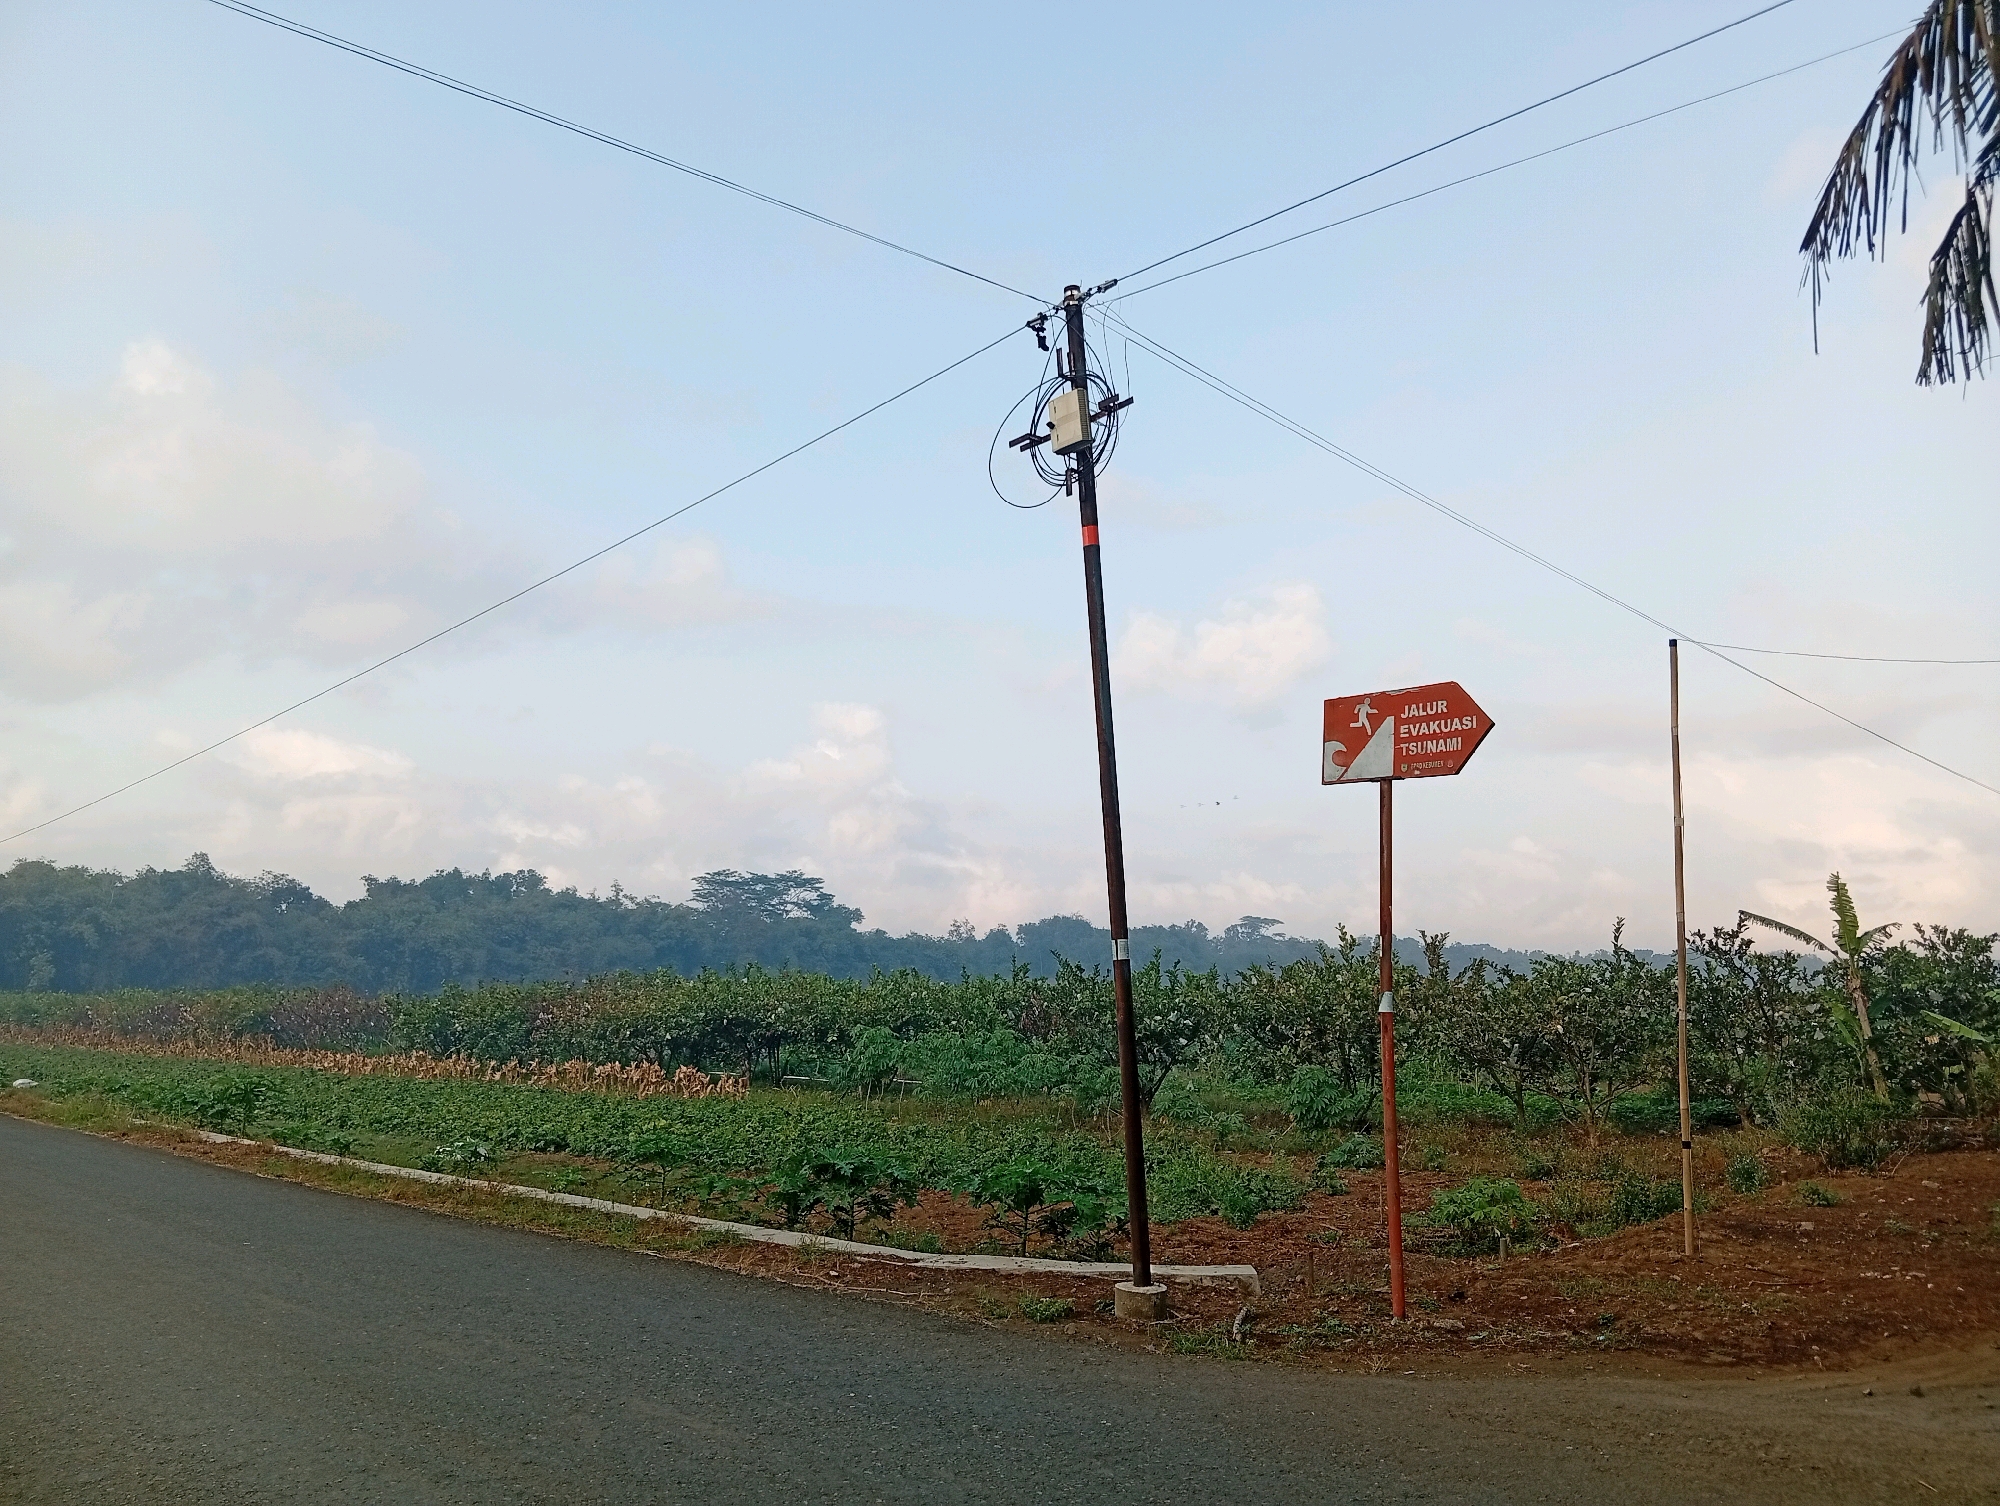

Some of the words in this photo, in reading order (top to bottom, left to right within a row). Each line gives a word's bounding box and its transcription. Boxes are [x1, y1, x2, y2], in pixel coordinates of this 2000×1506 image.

[1400, 700, 1448, 719] JALUR
[1400, 715, 1477, 738] EVAKUASI
[1400, 737, 1462, 756] TSUNAMI
